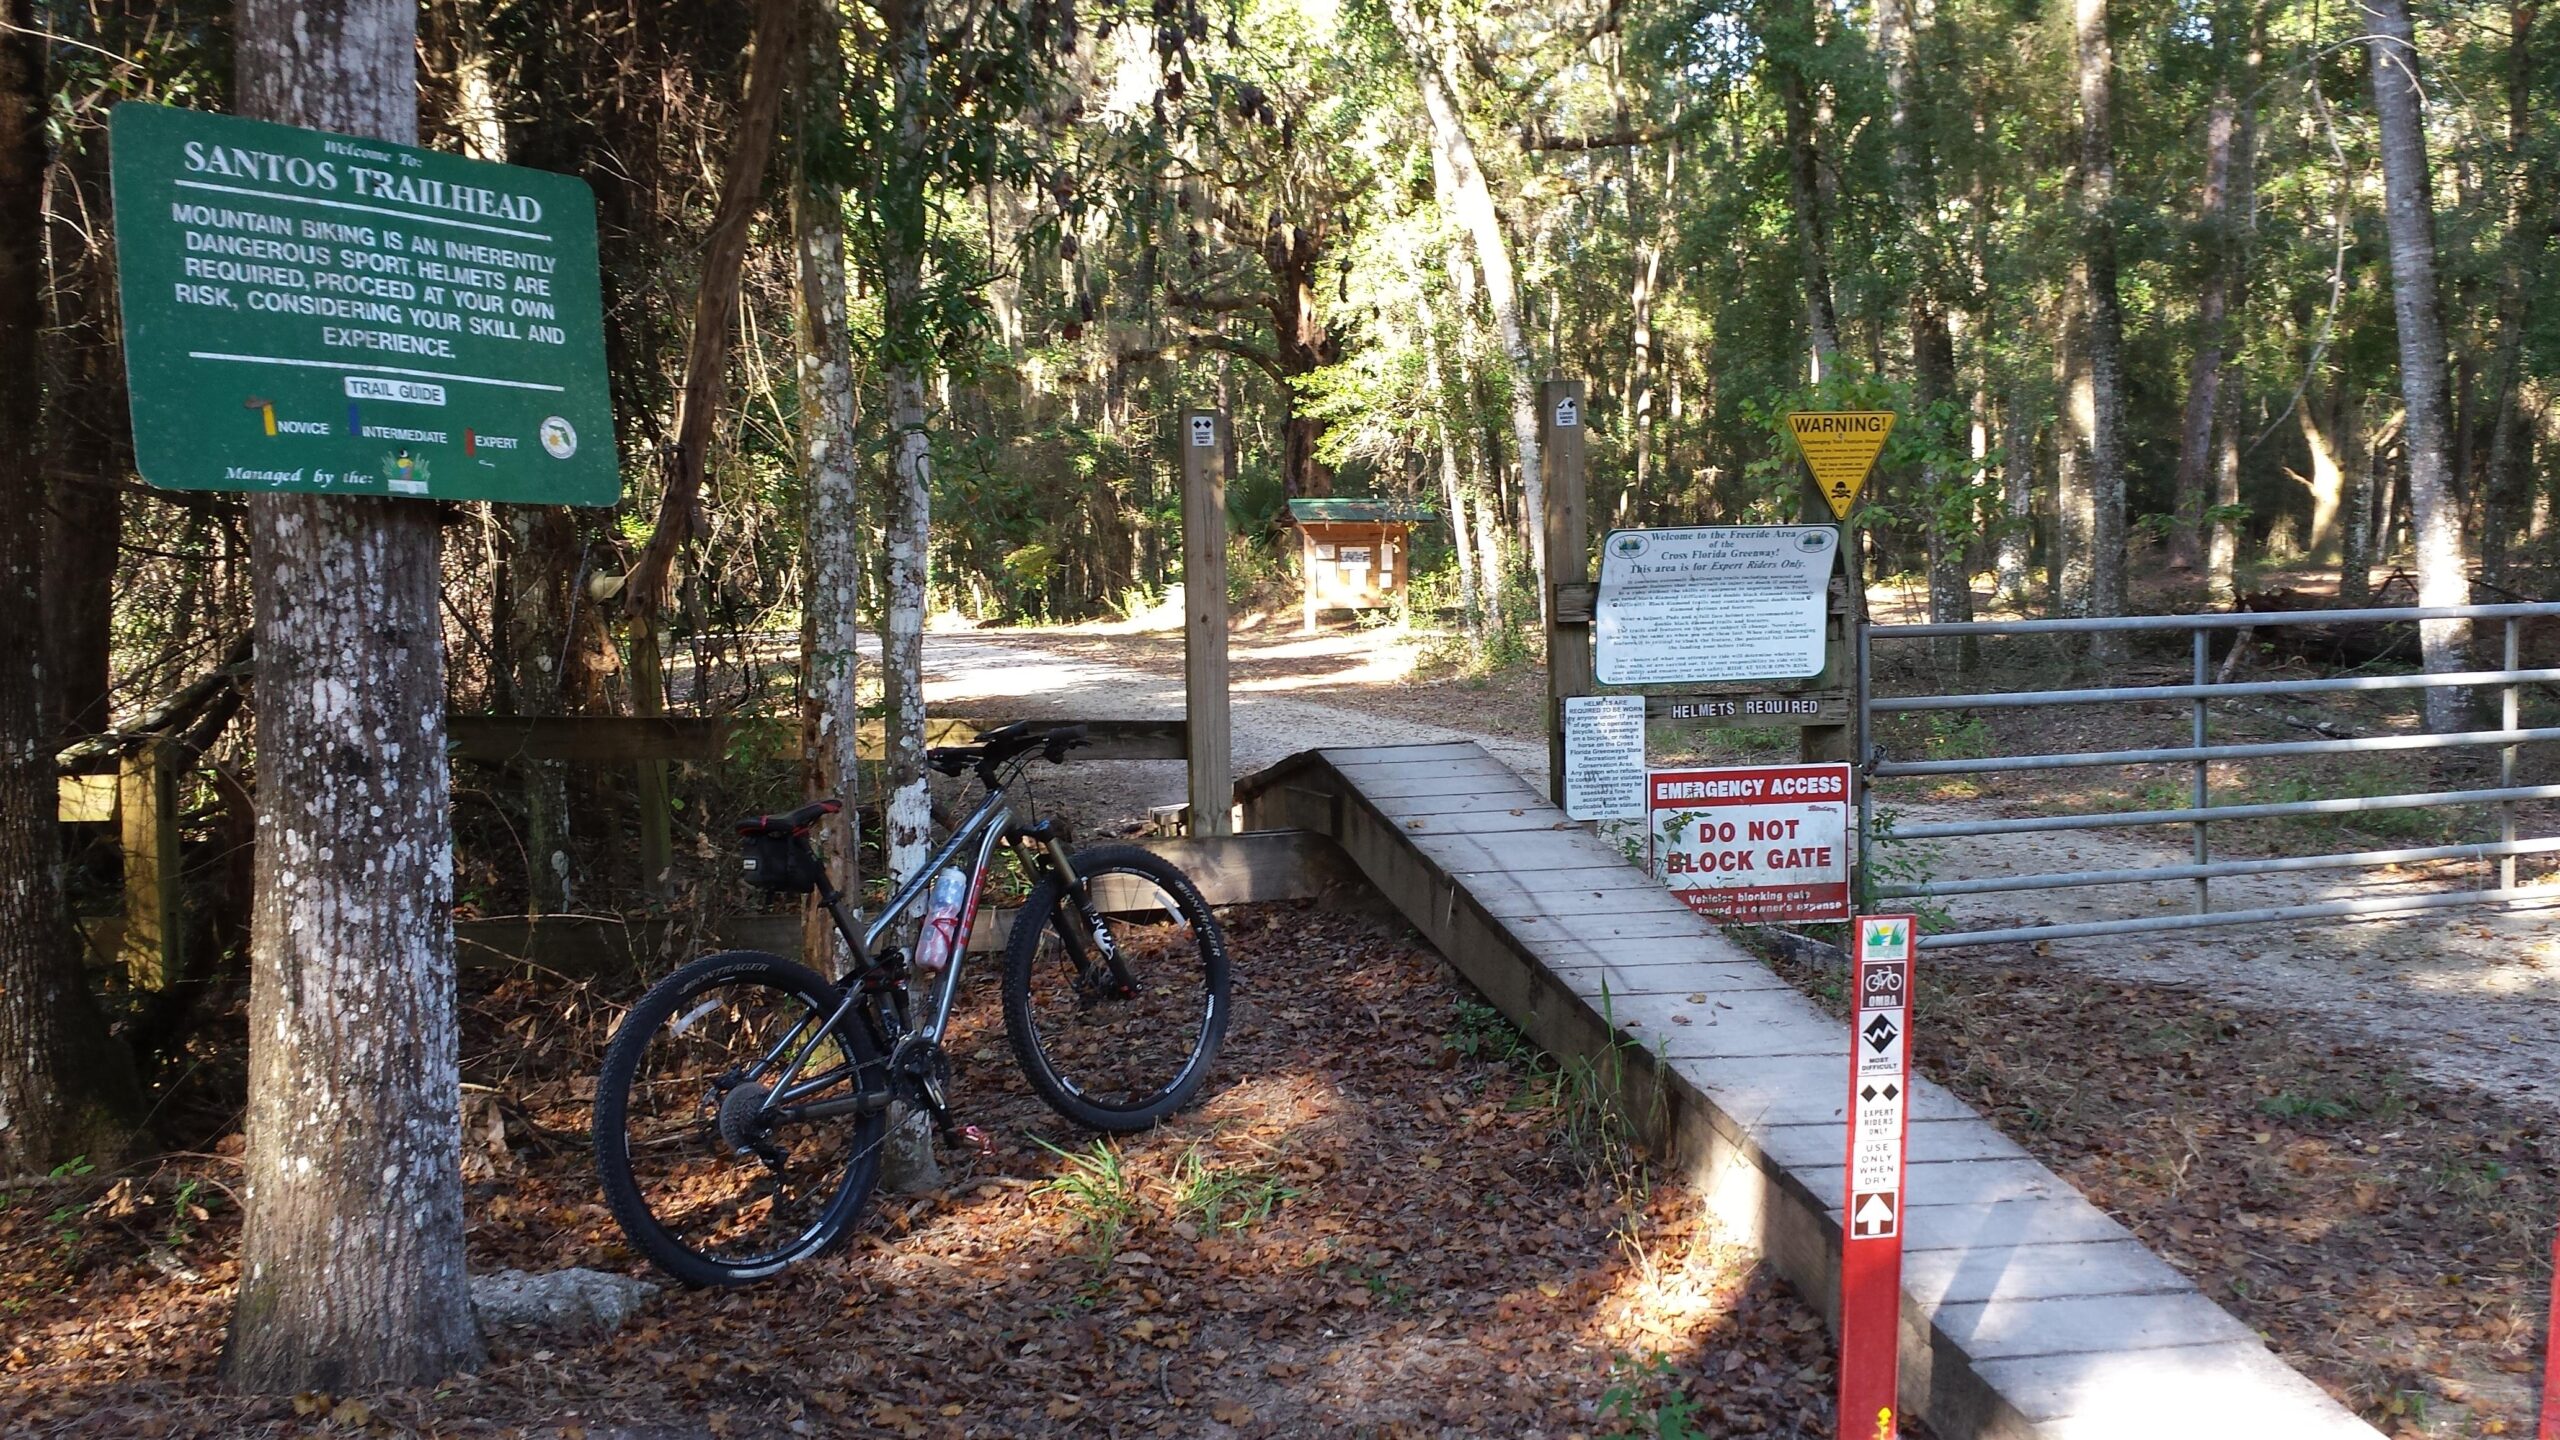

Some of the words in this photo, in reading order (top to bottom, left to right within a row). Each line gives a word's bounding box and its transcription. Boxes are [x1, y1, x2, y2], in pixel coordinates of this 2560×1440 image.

[325, 140, 391, 162] Welcome
[399, 153, 423, 169] To:
[184, 141, 338, 190] SANTOS
[347, 165, 542, 223] TRAILHEAD
[172, 203, 292, 236] MOUNTAIN
[301, 219, 376, 247] BIKING
[382, 230, 403, 250] IS
[411, 235, 438, 256] AN
[444, 241, 556, 274] INHERENTLY
[186, 231, 331, 266] DANGEROUS
[417, 260, 507, 290] HELMETS
[514, 276, 551, 297] ARE
[185, 257, 310, 292] REQUIRED,
[314, 271, 416, 300] PROCEED
[423, 286, 445, 305] AT
[452, 290, 505, 314] YOUR
[511, 298, 555, 320] OWN
[175, 283, 238, 311] RISK,
[247, 290, 402, 324] CONSIDERING
[409, 308, 462, 332] YOUR
[469, 317, 522, 340] SKILL
[528, 324, 566, 345] AND
[322, 326, 456, 359] EXPERIENCE.
[350, 381, 394, 397] TRAIL
[399, 385, 441, 401] GUIDE
[1794, 417, 1886, 433] WARNING!
[277, 421, 330, 435] NOVICE
[362, 426, 448, 444] INTERMEDIATE
[475, 435, 518, 449] EXPERT
[224, 467, 303, 487] Managed
[313, 469, 334, 488] by
[342, 471, 373, 484] the:
[1651, 532, 1693, 540] Welcome
[1711, 531, 1726, 539] the
[1730, 530, 1770, 538] Freeride
[1661, 551, 1688, 560] Cross
[1692, 550, 1726, 559] Florida
[1730, 548, 1780, 558] Greenway!
[1630, 565, 1651, 574] This
[1681, 563, 1689, 571] is
[1693, 562, 1707, 571] for
[1711, 562, 1743, 571] Expert
[1747, 560, 1777, 569] Riders
[1781, 560, 1806, 569] Only.
[1672, 702, 1736, 719] HELMETS
[1746, 700, 1818, 714] REQUIRED
[1656, 779, 1765, 800] EMERGENCY
[1770, 776, 1842, 795] ACCESS
[1700, 822, 1736, 843] DO
[1748, 819, 1800, 841] NOT
[1667, 850, 1754, 874] BLOCK
[1766, 847, 1832, 869] GATE
[1737, 891, 1783, 903] blocking
[1787, 890, 1810, 902] gate
[1736, 906, 1747, 914] at
[1751, 903, 1792, 914] owner's
[1796, 901, 1842, 912] expense
[1174, 880, 1221, 957] BONTRAGER
[1868, 994, 1897, 1007] OMBA
[1862, 1063, 1897, 1071] DIFFICULT
[1864, 1108, 1894, 1117] EXPERT
[1864, 1118, 1893, 1126] RIDERS
[1866, 1144, 1889, 1152] USE
[1862, 1155, 1892, 1163] ONLY
[1860, 1166, 1894, 1174] WHEN
[1865, 1177, 1887, 1185] DRY
